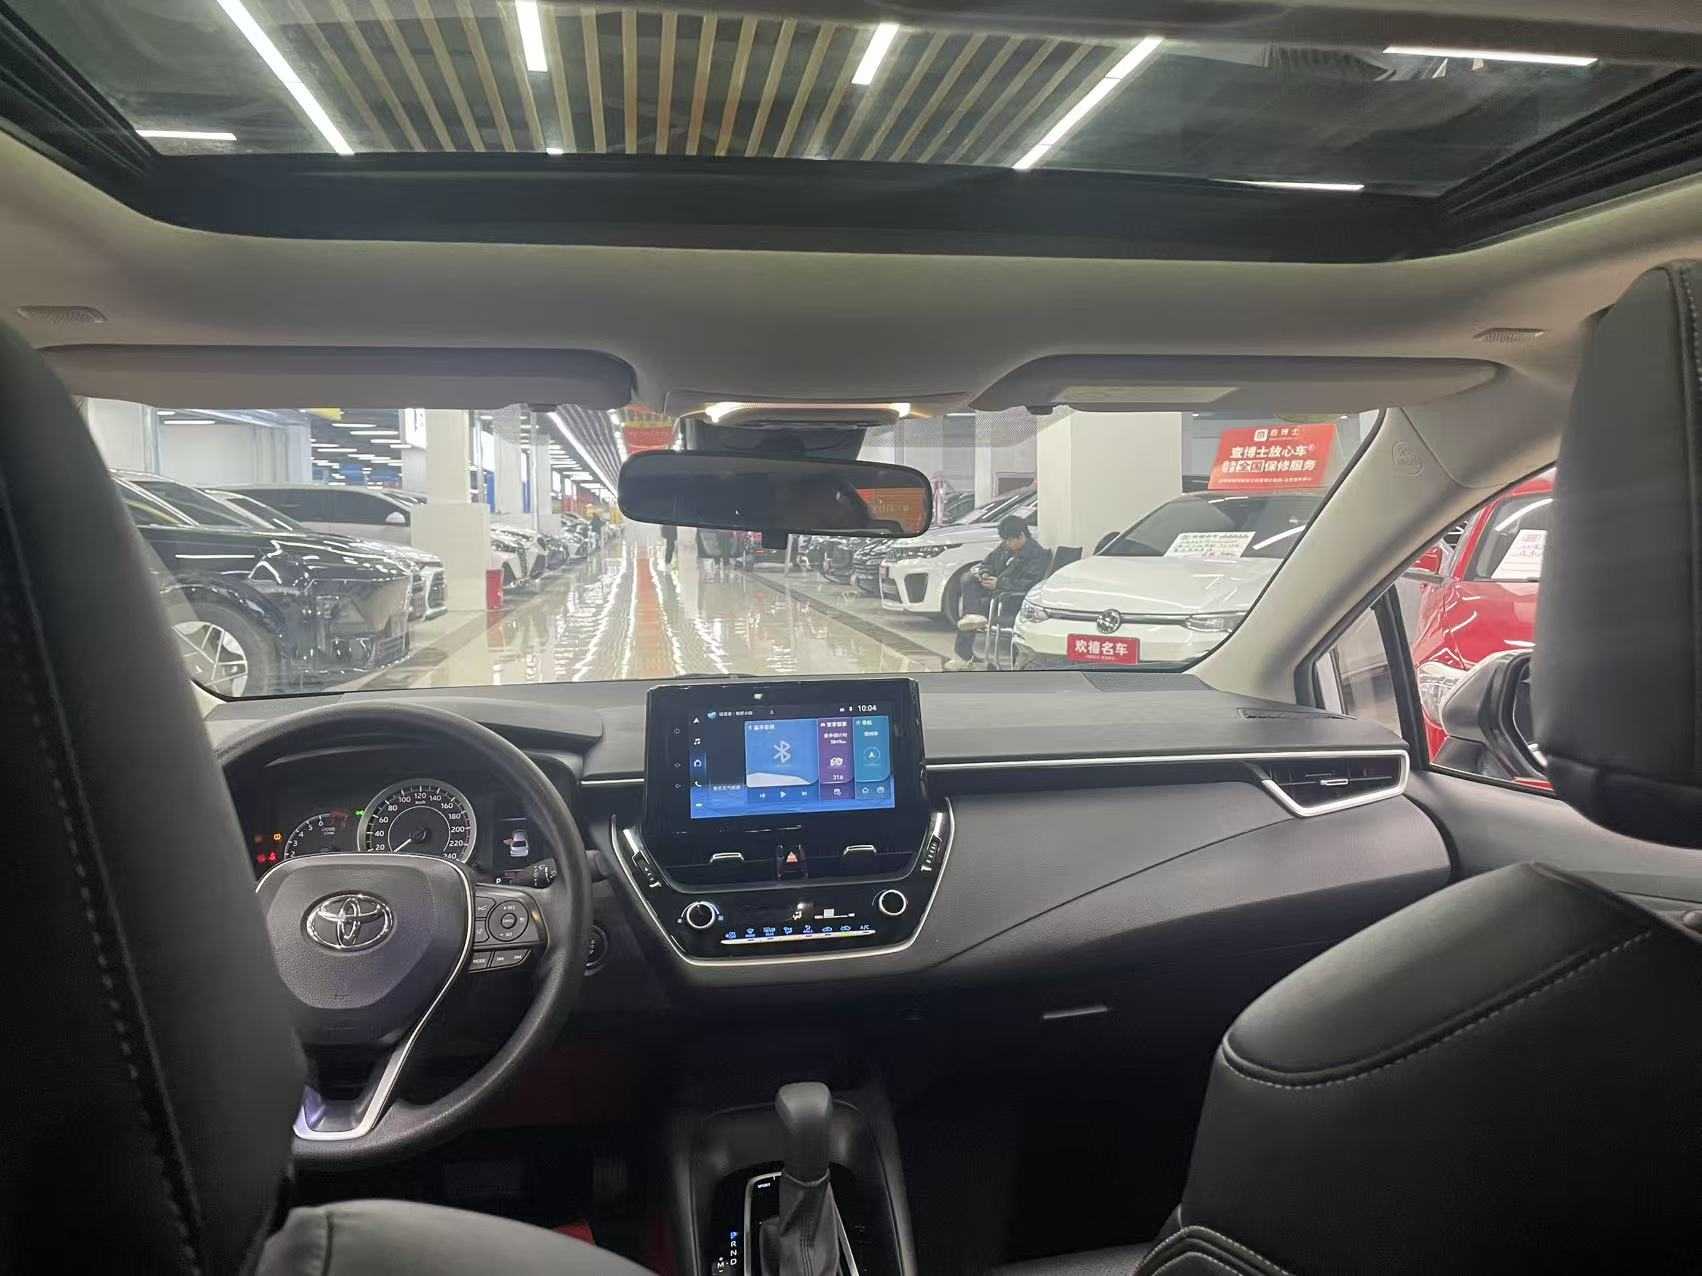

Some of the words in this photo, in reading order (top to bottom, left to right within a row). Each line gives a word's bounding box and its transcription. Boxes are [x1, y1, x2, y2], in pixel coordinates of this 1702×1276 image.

[1230, 445, 1308, 459] 查博士放心车
[857, 704, 877, 712] 10:04
[730, 1231, 737, 1240] P
[730, 1249, 737, 1257] N
[717, 1261, 725, 1269] M
[730, 1258, 737, 1266] D
